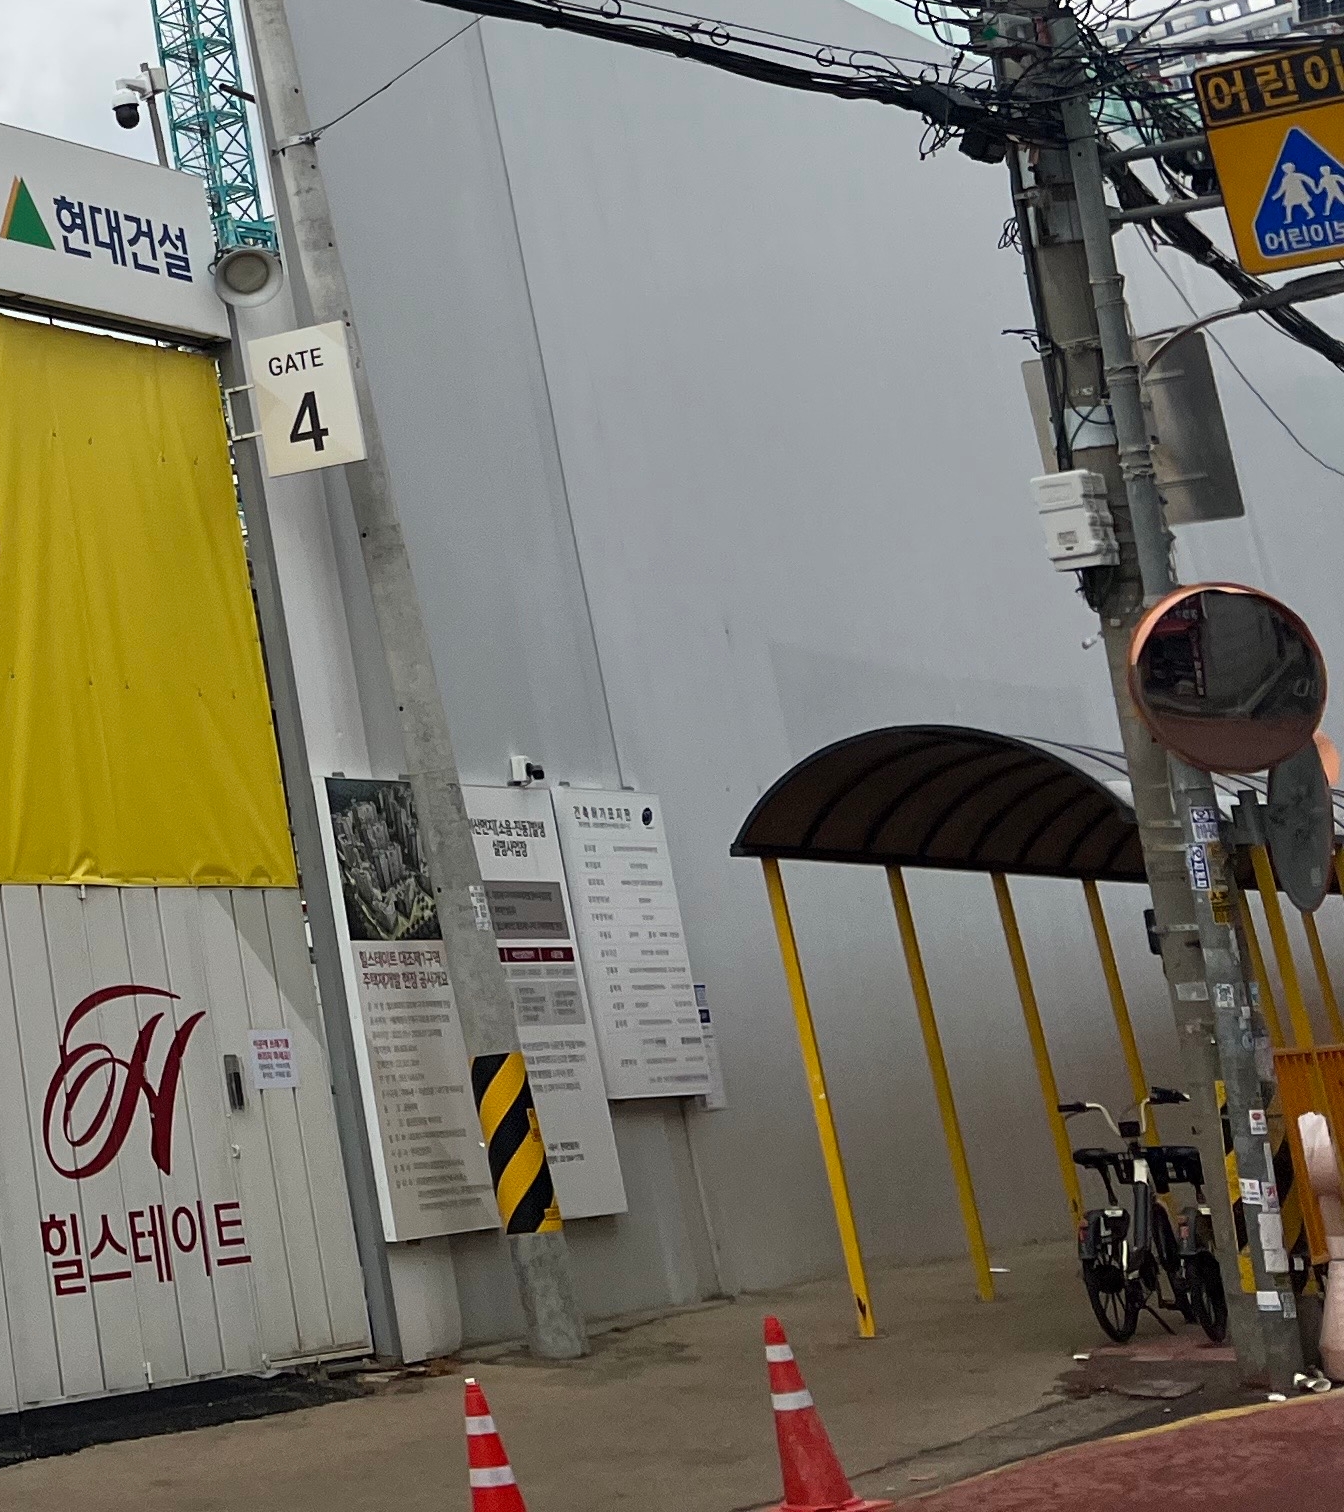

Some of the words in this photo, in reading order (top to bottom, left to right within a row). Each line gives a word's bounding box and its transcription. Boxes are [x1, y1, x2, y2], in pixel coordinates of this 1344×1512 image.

[1207, 47, 1344, 115] 어린이
[52, 194, 194, 284] 현대건설
[268, 347, 325, 378] GATE
[289, 390, 330, 453] 4
[40, 1199, 252, 1296] 힐스테이트
